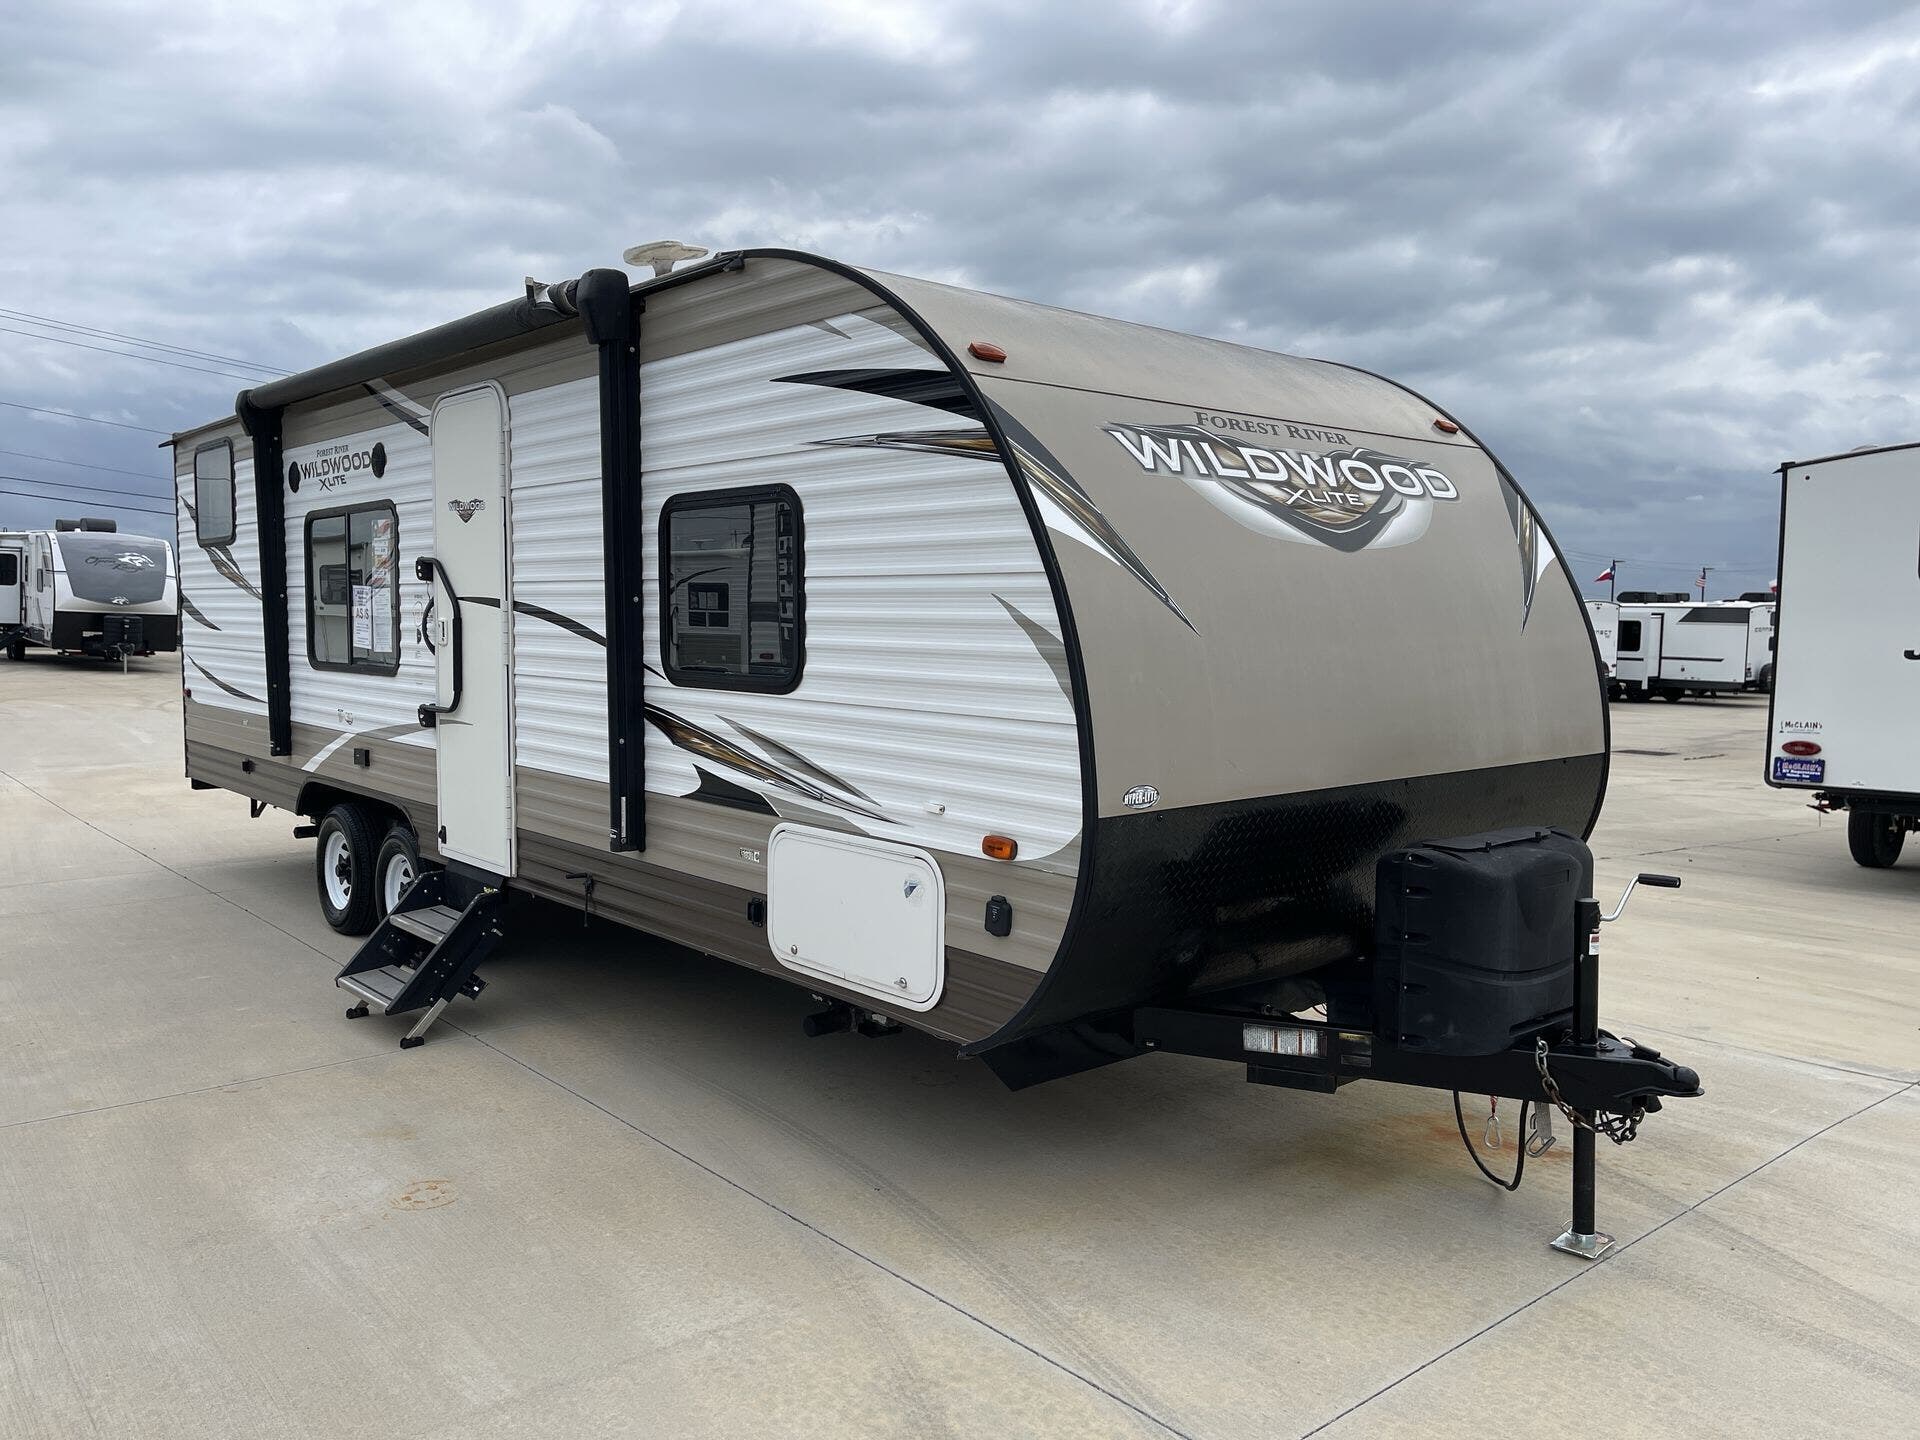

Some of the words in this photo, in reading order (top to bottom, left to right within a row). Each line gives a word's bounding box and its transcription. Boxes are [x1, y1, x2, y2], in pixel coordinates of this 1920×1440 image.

[1194, 411, 1279, 436] FOREST
[1284, 423, 1353, 446] RIVER
[300, 451, 371, 479] WILDWOOD
[1107, 429, 1459, 500] WILDWOOD
[319, 474, 347, 492] XLITE
[447, 501, 486, 512] WILDWOOD
[1283, 486, 1364, 507] XLITE
